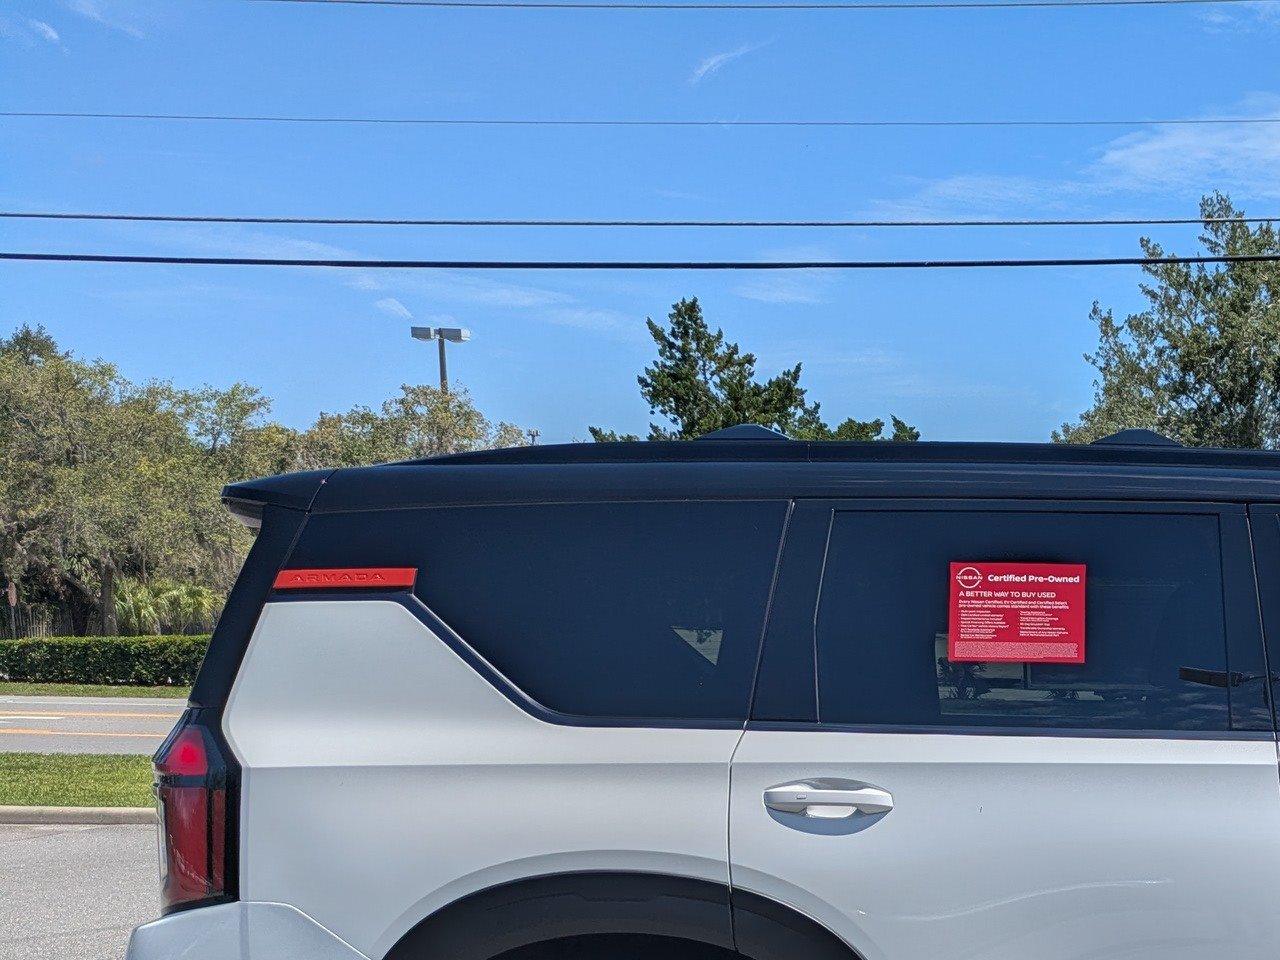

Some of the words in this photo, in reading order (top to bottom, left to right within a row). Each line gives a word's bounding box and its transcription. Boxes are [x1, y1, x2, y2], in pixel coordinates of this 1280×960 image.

[290, 573, 385, 583] ARMADA
[988, 574, 1027, 582] Certified
[1028, 575, 1080, 583] Pre-Owned
